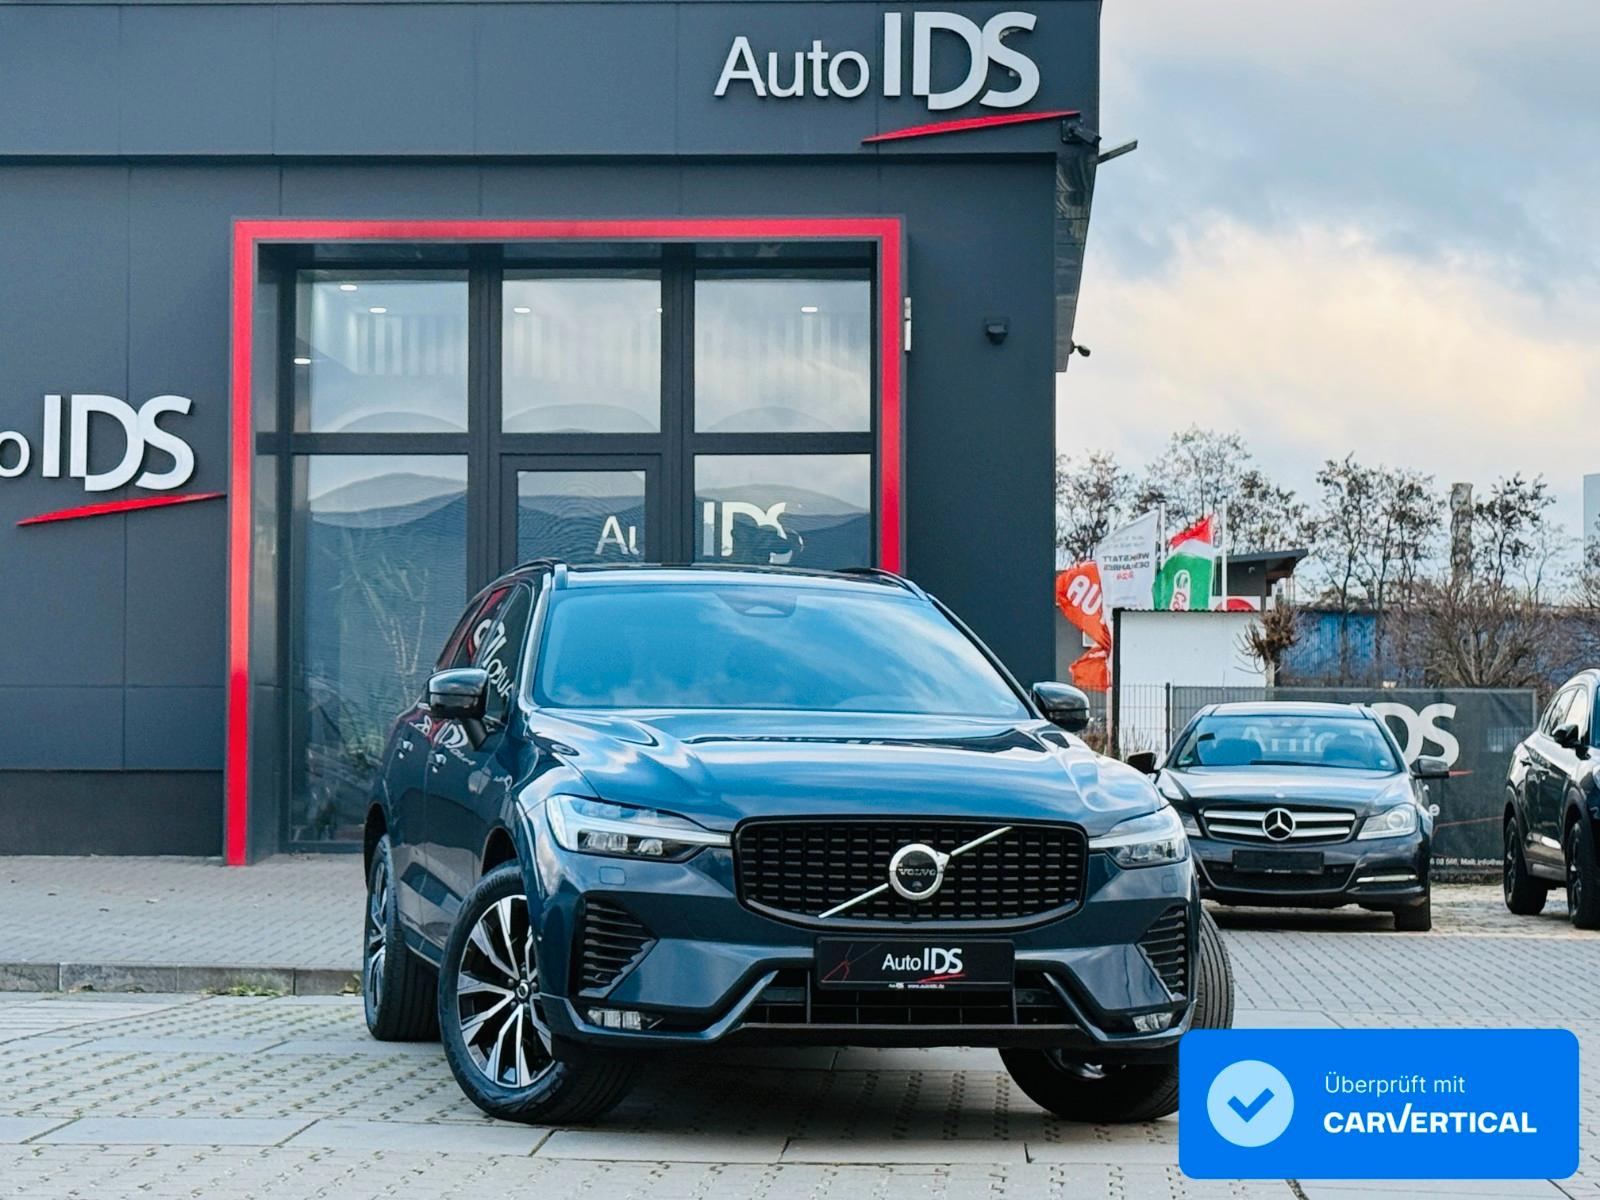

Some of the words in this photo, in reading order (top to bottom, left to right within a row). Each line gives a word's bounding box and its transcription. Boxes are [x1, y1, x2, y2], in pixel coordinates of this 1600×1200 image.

[714, 36, 870, 98] Auto
[884, 11, 1040, 110] IDS
[42, 394, 195, 491] IDS
[898, 868, 936, 876] VOLVO
[882, 953, 921, 971] Auto
[923, 948, 963, 974] IDS
